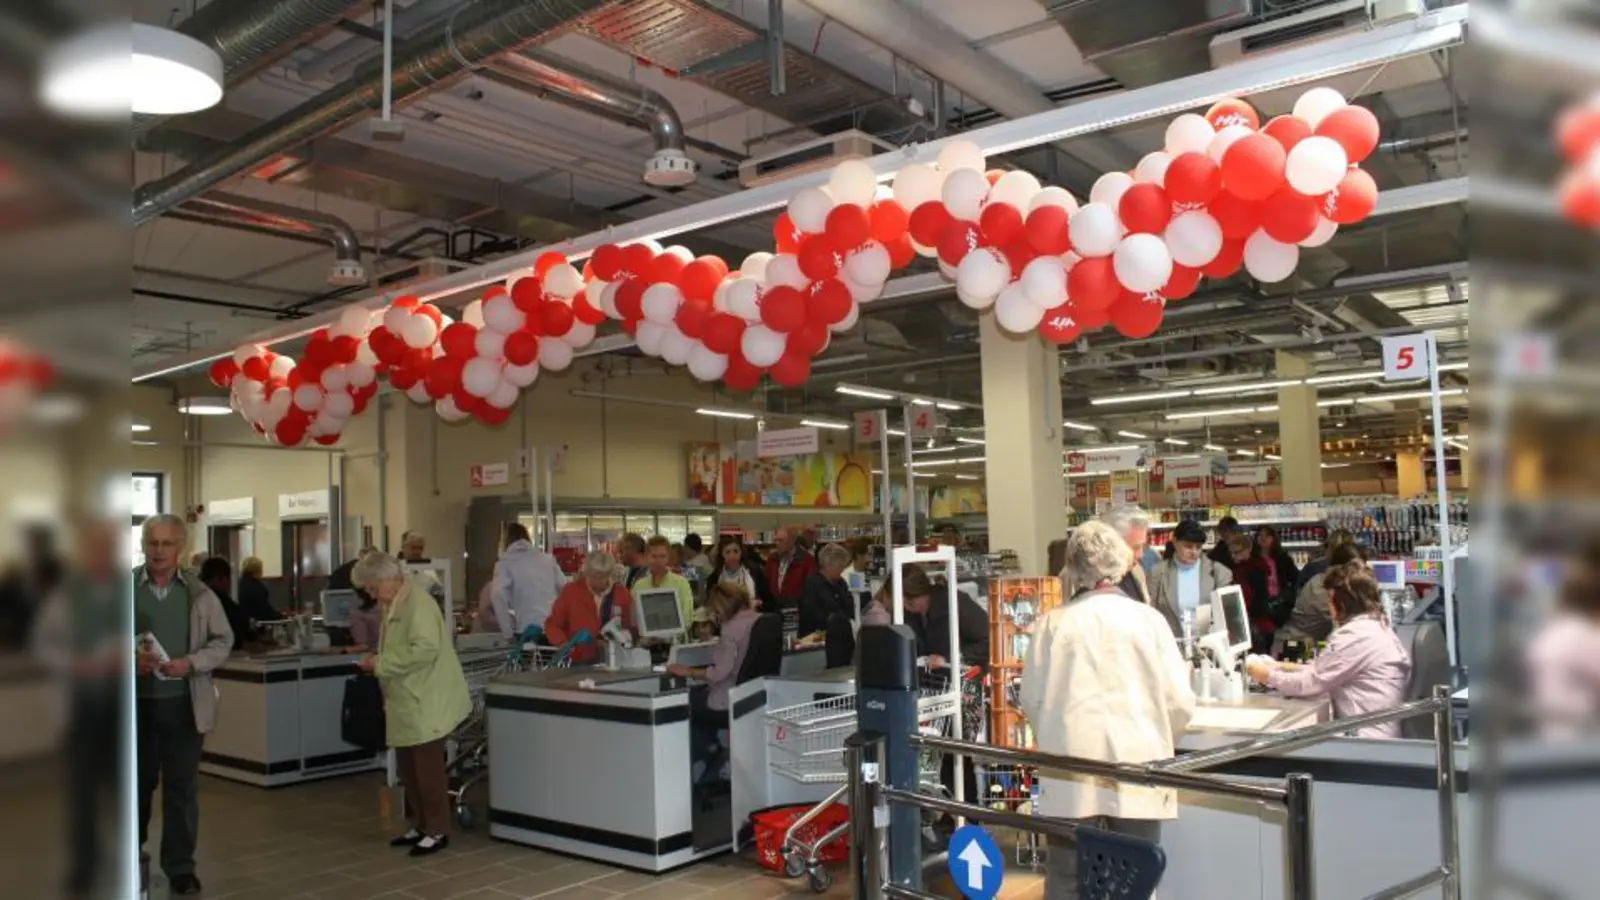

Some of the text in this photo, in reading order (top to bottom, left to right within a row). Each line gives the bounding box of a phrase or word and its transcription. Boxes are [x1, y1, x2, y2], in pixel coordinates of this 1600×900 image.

[1396, 347, 1415, 370] 5
[861, 418, 874, 436] 3
[915, 412, 928, 430] 4
